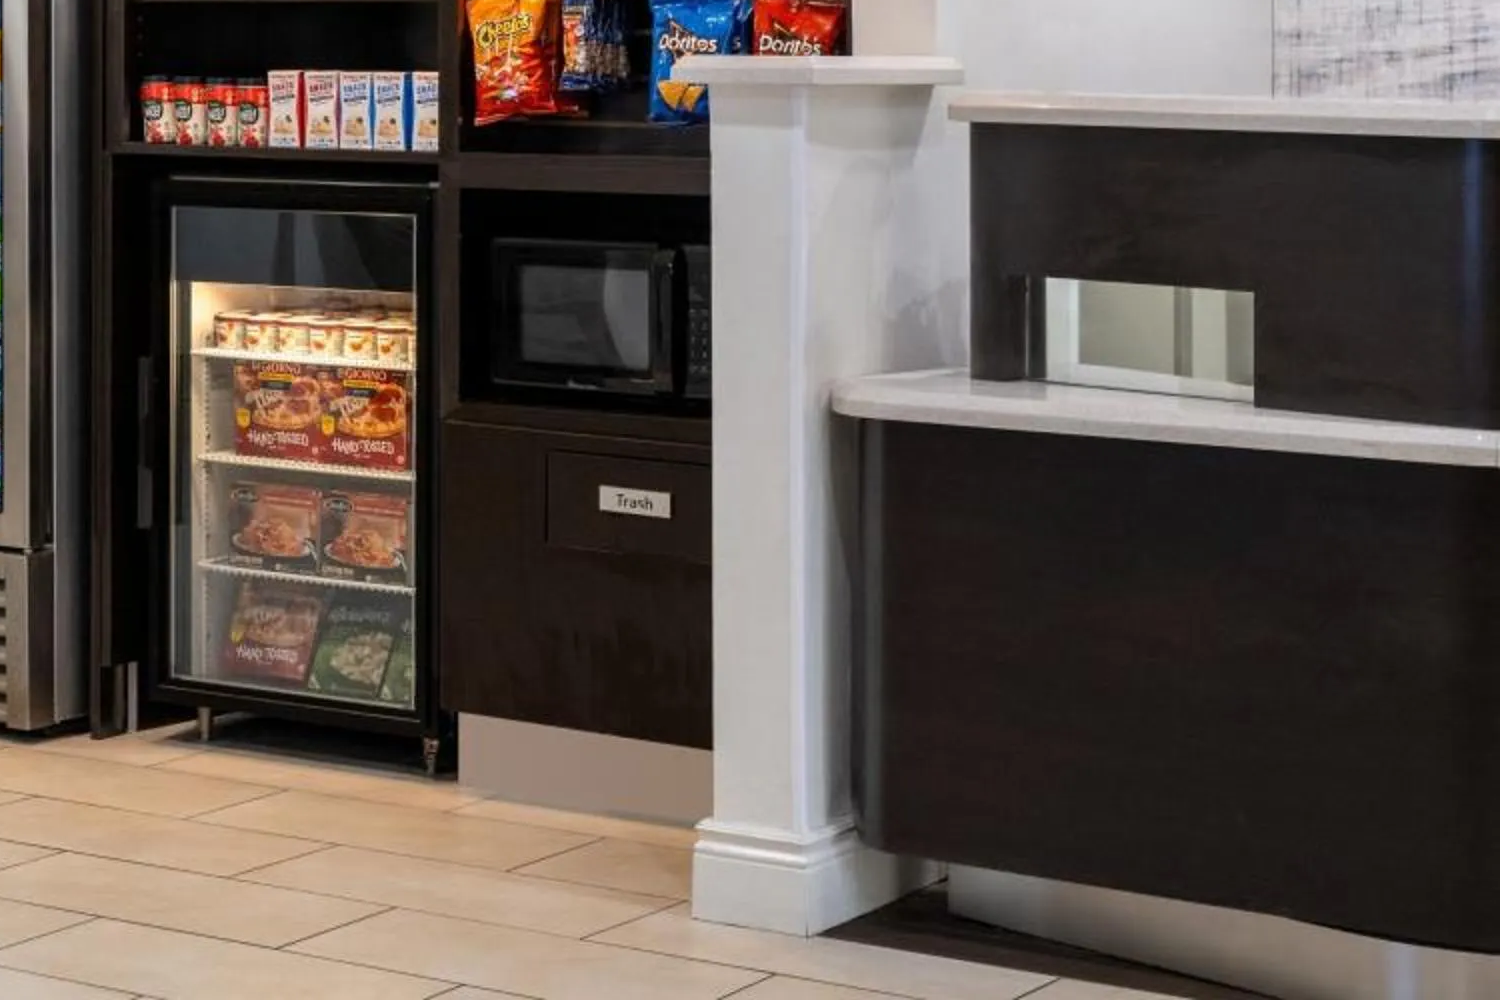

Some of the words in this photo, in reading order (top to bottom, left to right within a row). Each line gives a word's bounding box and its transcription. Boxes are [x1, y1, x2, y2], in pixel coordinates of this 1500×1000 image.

[476, 13, 532, 48] Cheetos
[659, 33, 718, 53] Doritos
[760, 35, 821, 56] Doritos
[616, 493, 654, 511] Trash
